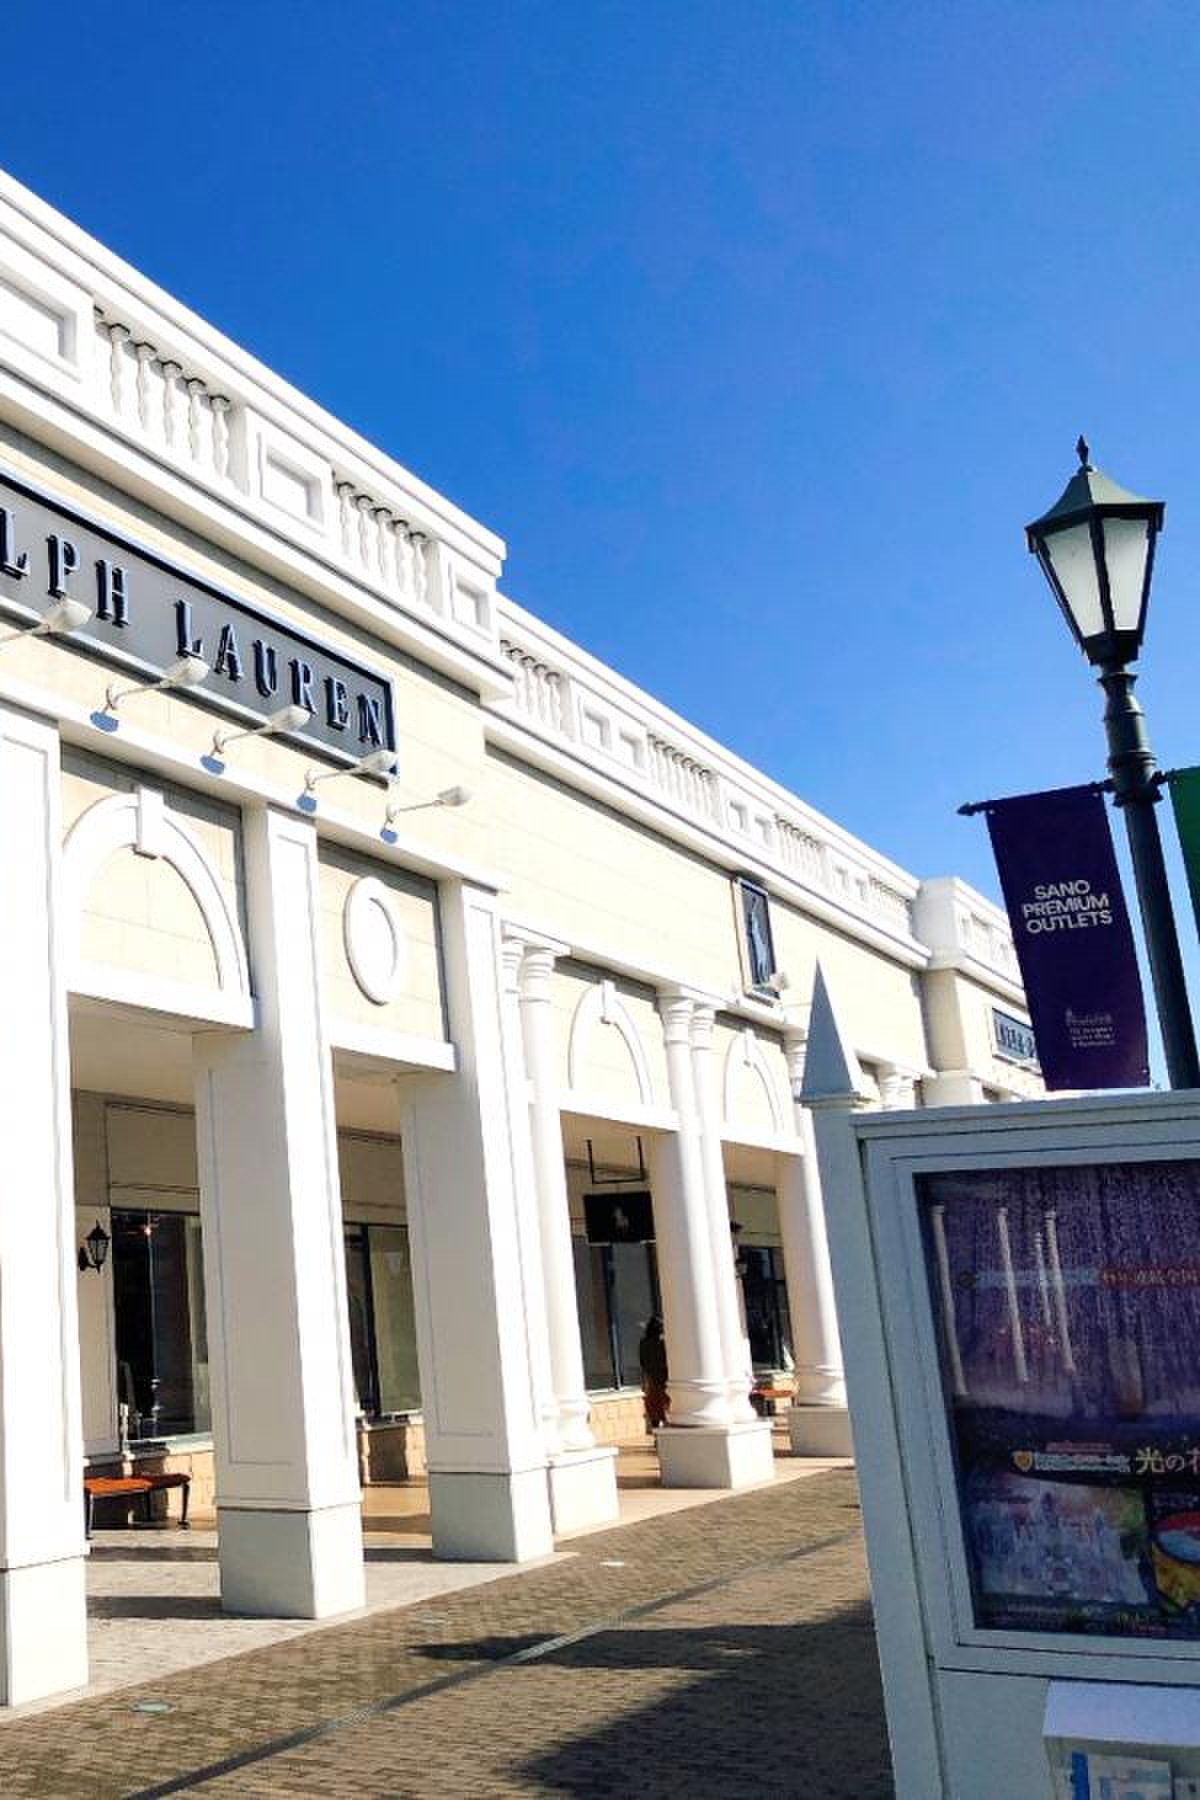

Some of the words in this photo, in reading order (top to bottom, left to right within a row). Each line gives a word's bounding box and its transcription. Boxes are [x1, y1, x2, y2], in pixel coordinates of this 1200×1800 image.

[175, 600, 385, 745] LAUREN
[1034, 879, 1090, 899] SANO
[1022, 893, 1109, 918] PREMIUM
[1027, 910, 1113, 933] OUTLETS
